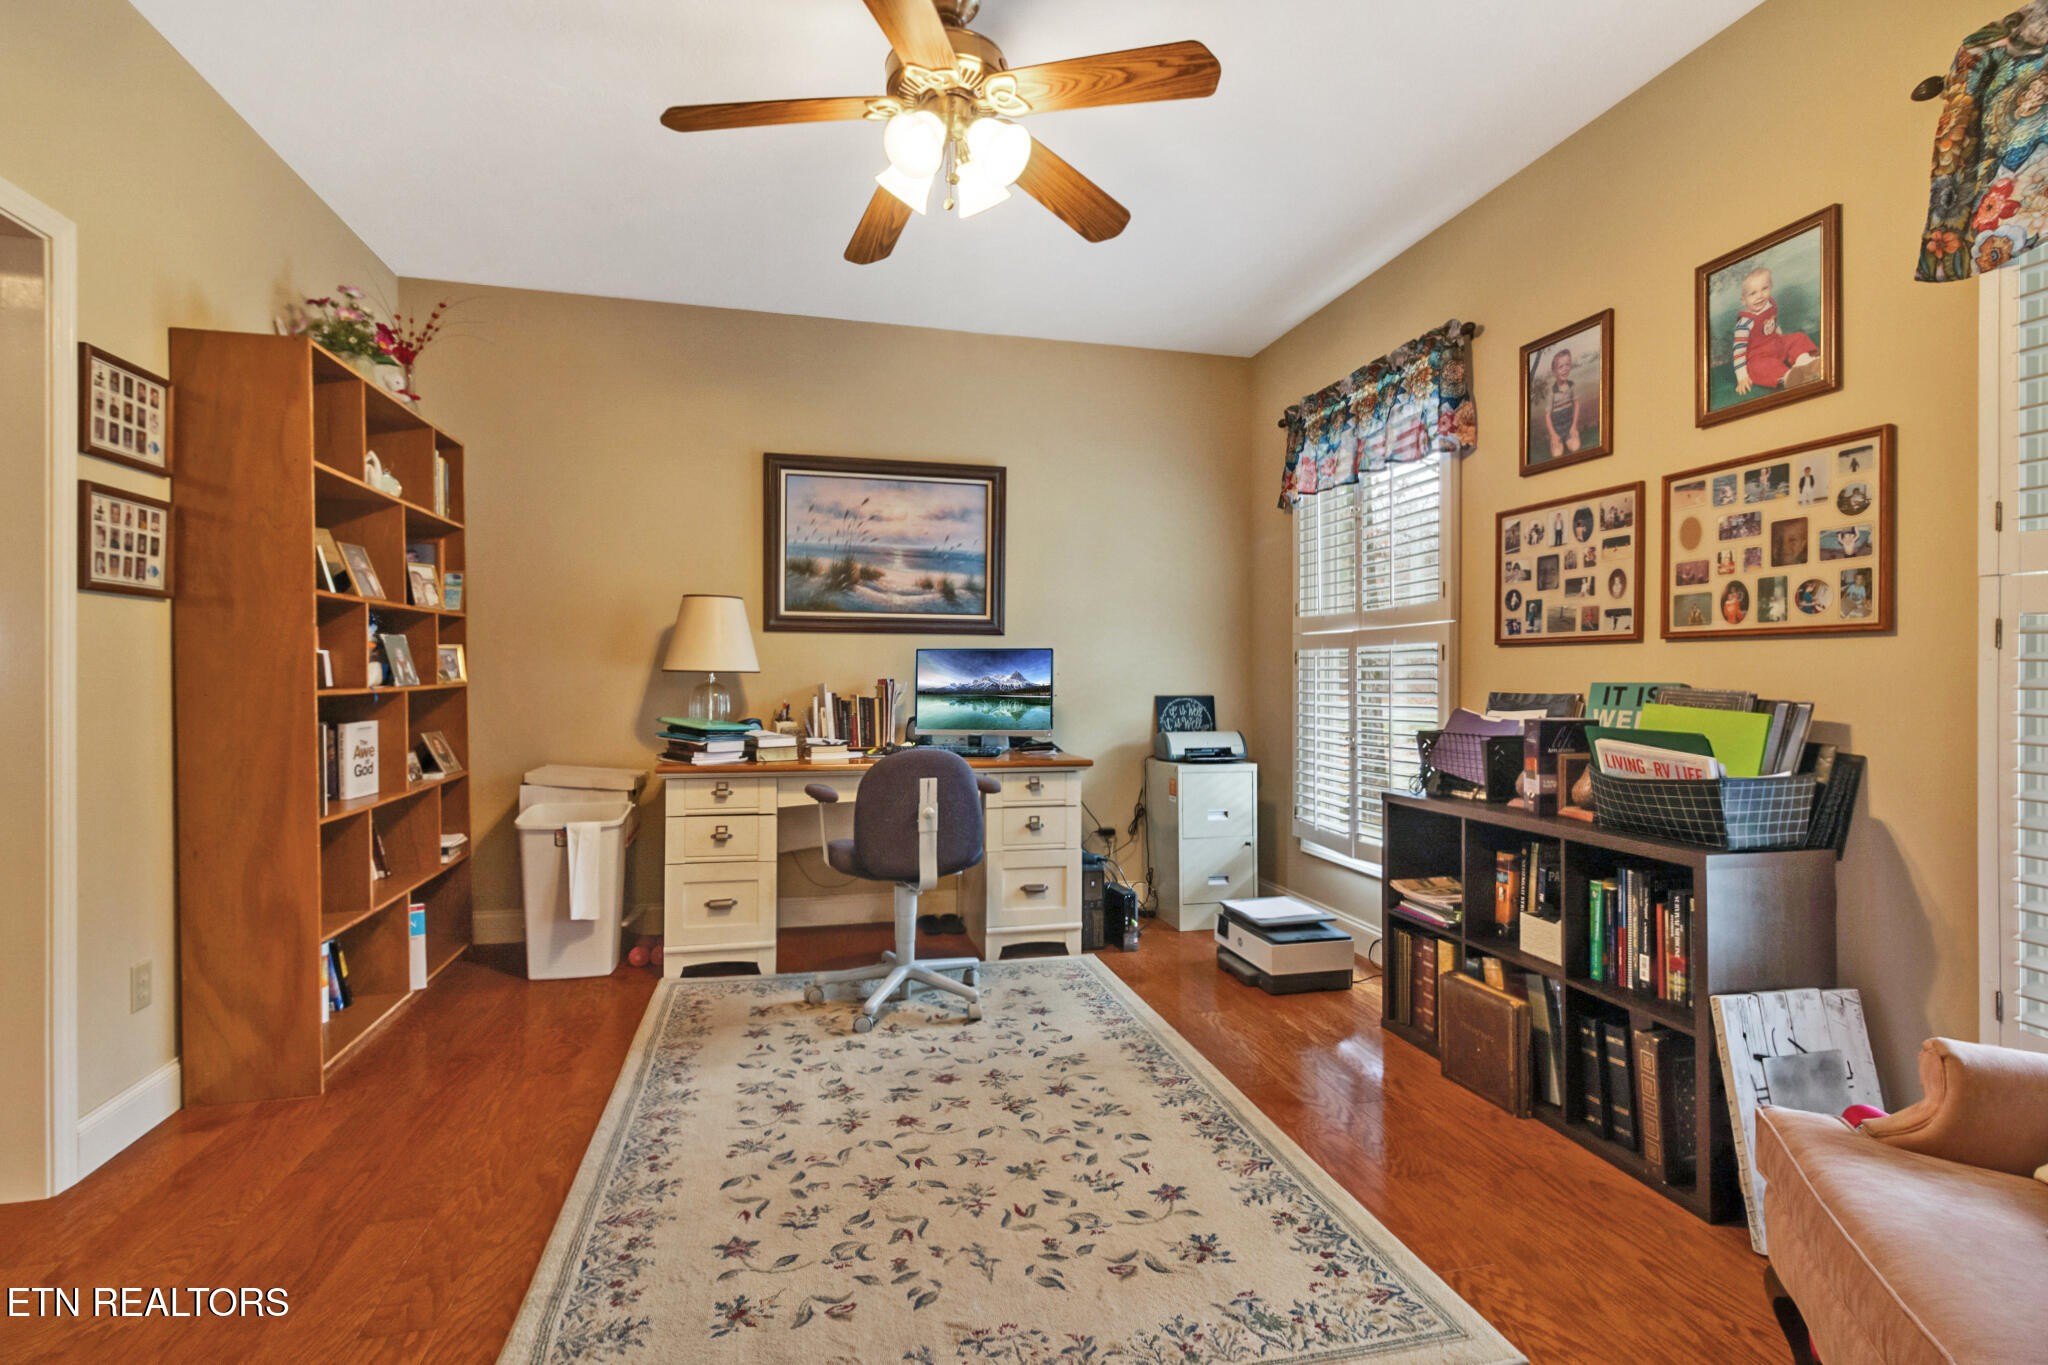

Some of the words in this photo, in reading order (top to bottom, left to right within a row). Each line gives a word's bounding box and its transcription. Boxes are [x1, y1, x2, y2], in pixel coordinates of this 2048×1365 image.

[1603, 686, 1628, 706] IT
[353, 745, 375, 760] Awe
[354, 763, 373, 777] God
[1604, 752, 1646, 775] LIVING
[1653, 760, 1671, 779] RV
